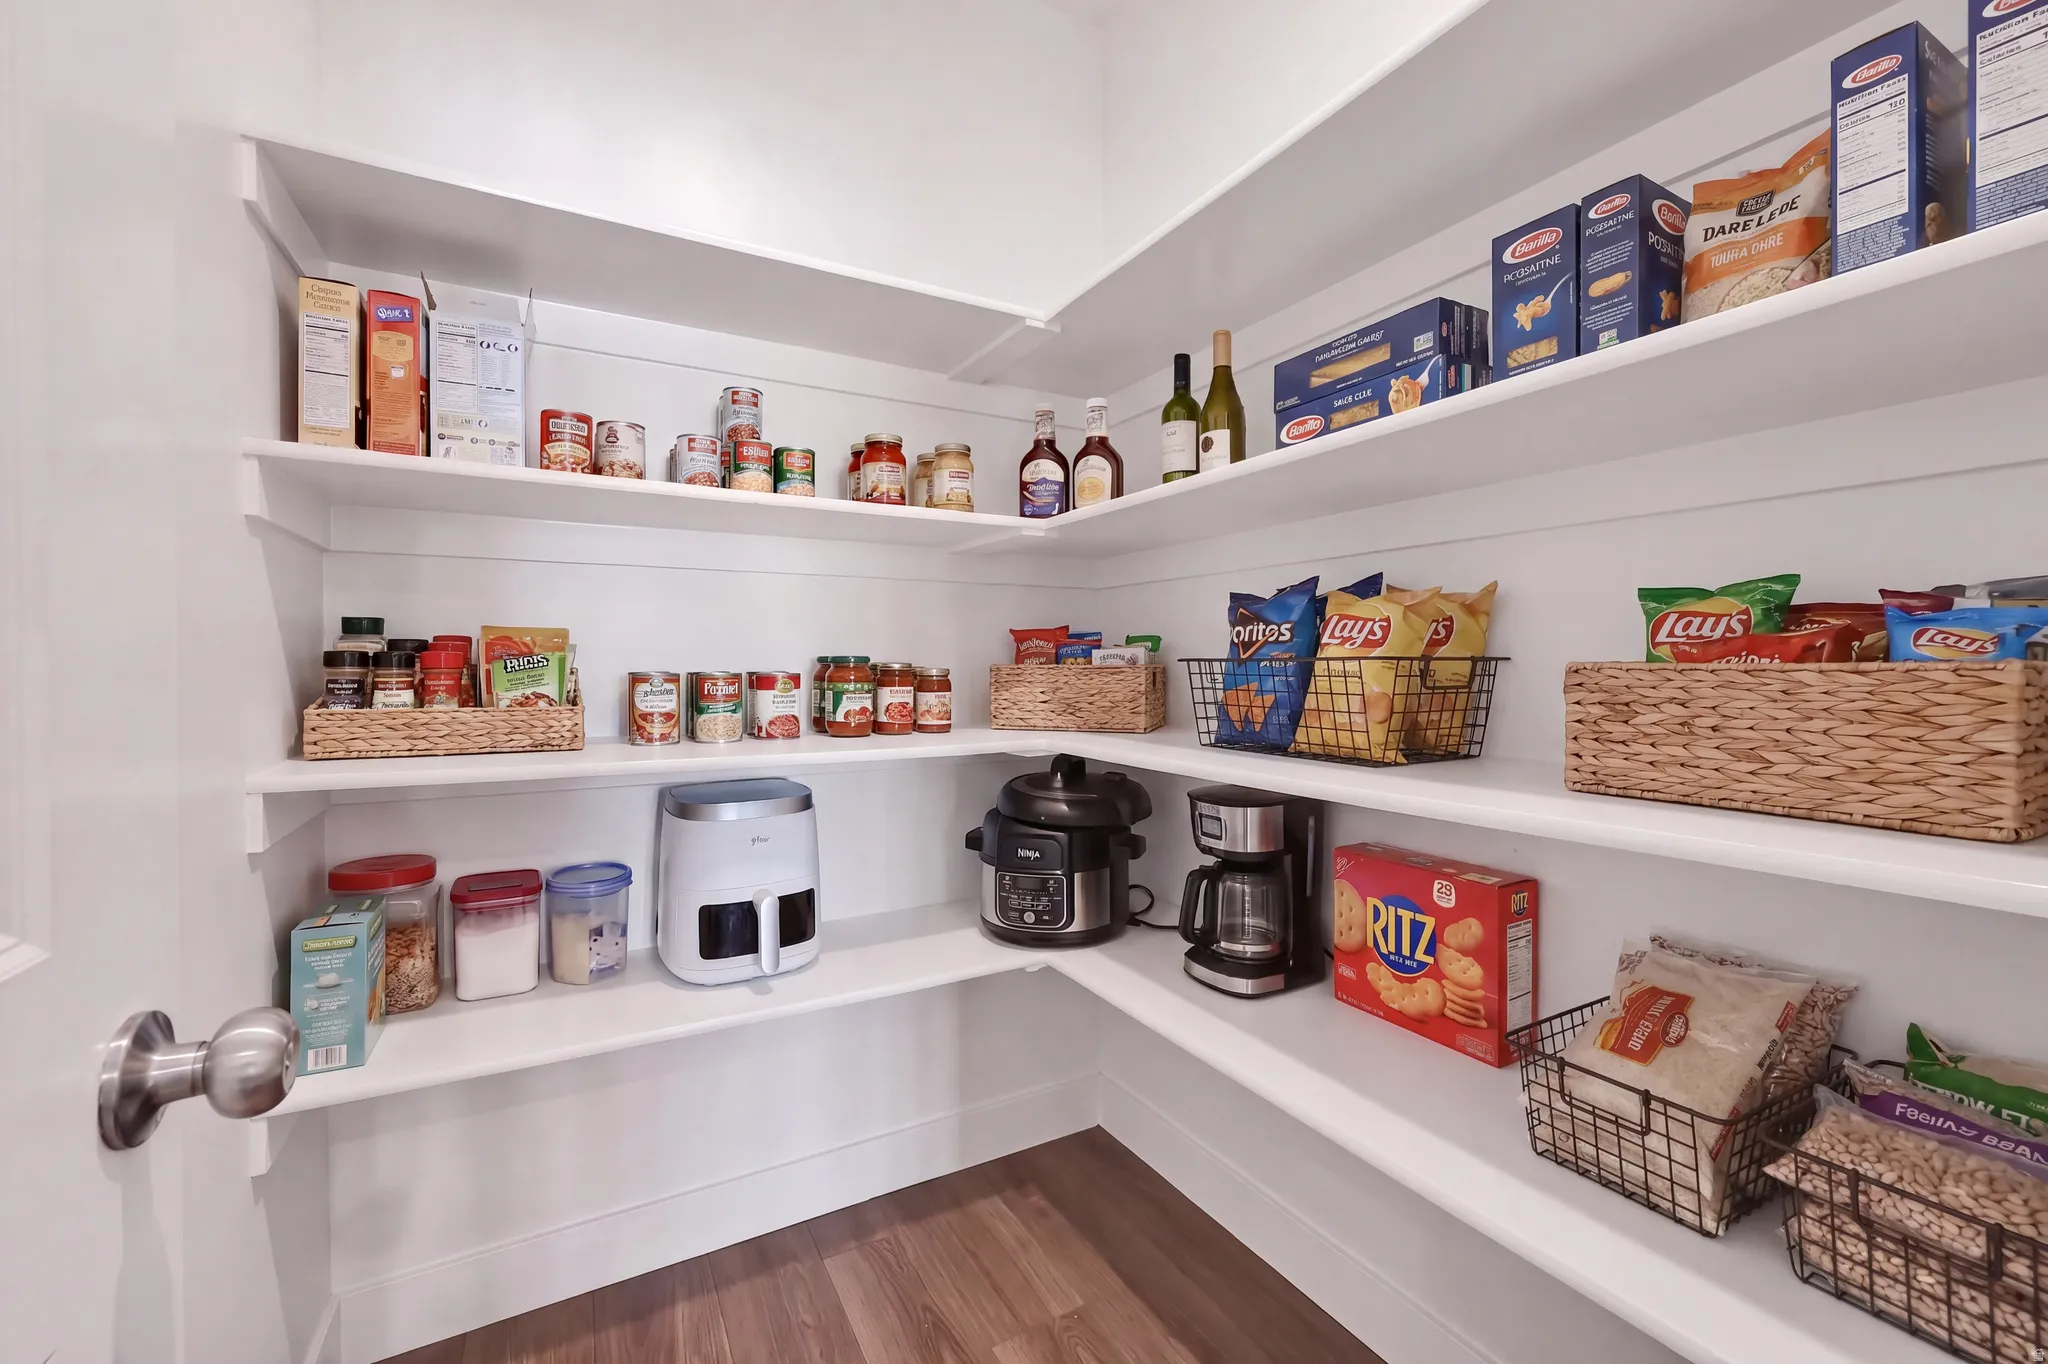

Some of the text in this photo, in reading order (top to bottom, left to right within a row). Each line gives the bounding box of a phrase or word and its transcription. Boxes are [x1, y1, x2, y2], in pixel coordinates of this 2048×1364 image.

[1514, 232, 1557, 257] Barilla
[1321, 613, 1389, 648] Lay's
[1655, 612, 1748, 643] Lay's
[1017, 848, 1041, 860] NINJA
[1511, 892, 1529, 913] RITZ
[1366, 896, 1436, 965] RITZ
